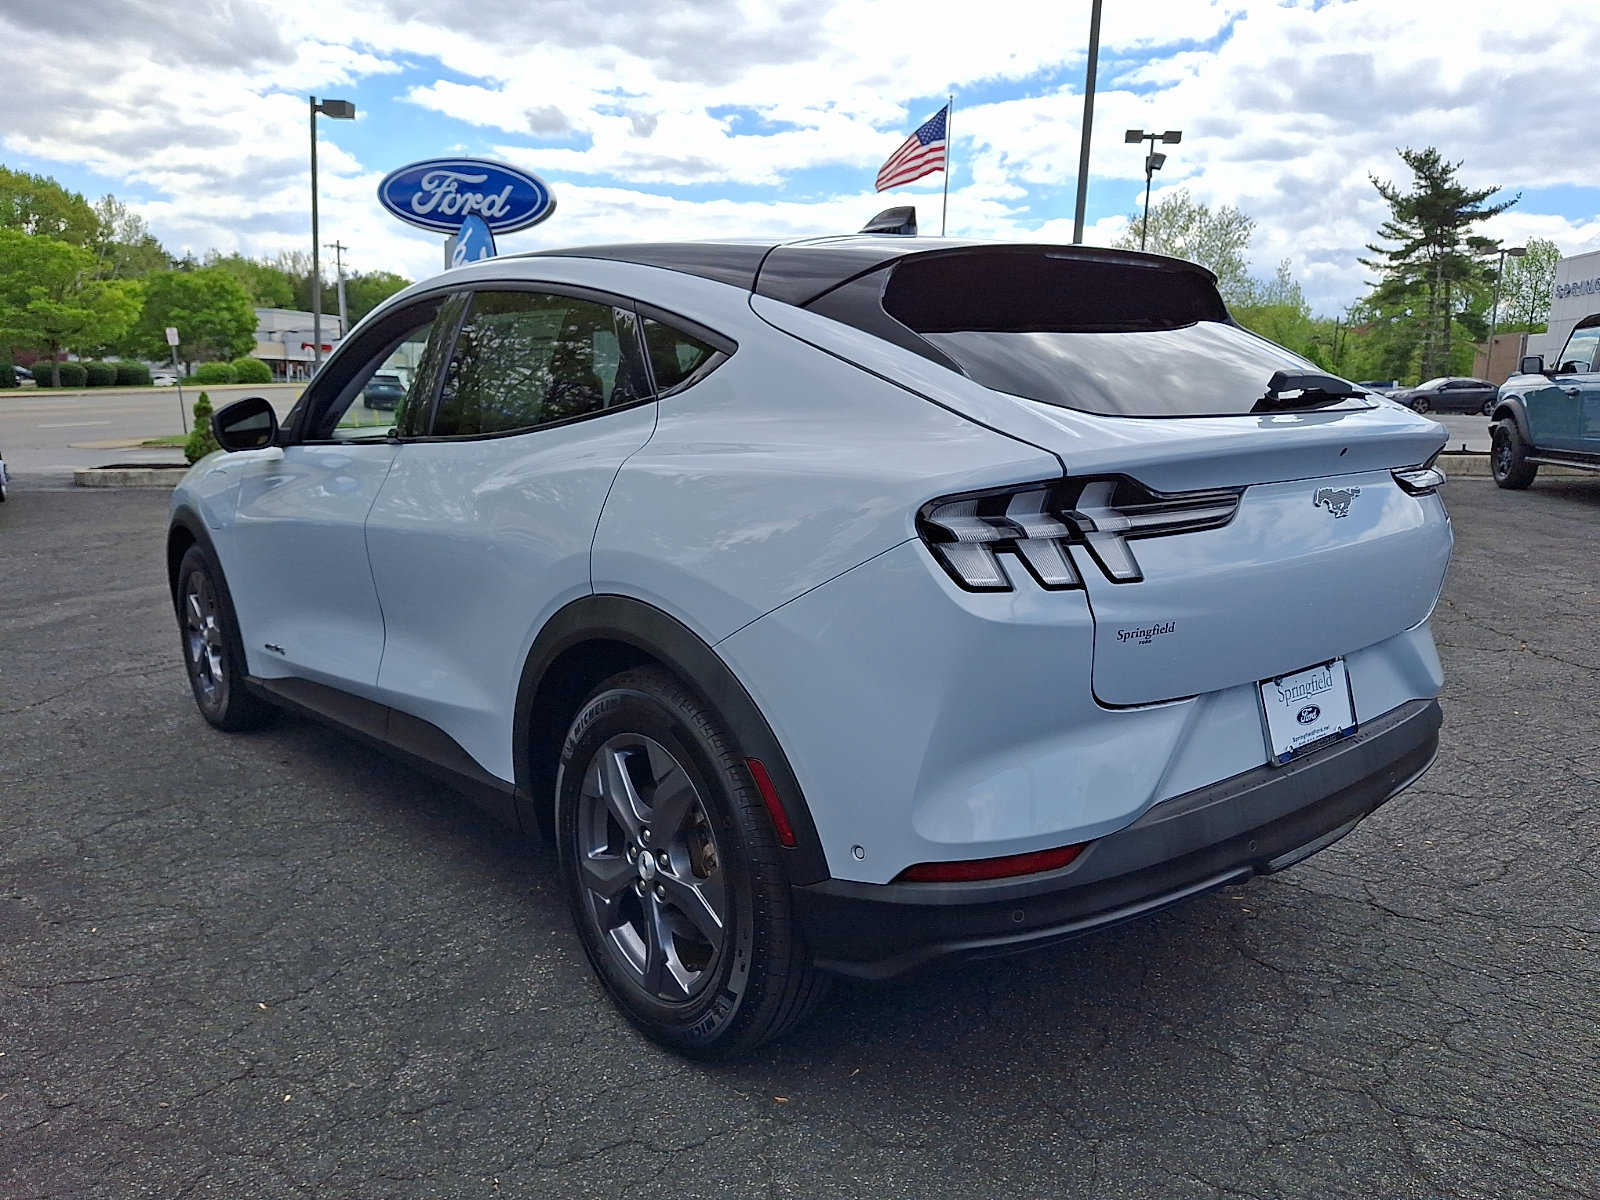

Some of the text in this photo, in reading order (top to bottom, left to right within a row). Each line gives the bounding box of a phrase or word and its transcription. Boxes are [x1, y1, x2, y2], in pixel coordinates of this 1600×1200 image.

[412, 170, 514, 218] Ford
[1116, 621, 1176, 643] Springfield
[1277, 670, 1333, 707] Springfield
[1300, 706, 1318, 723] Ford
